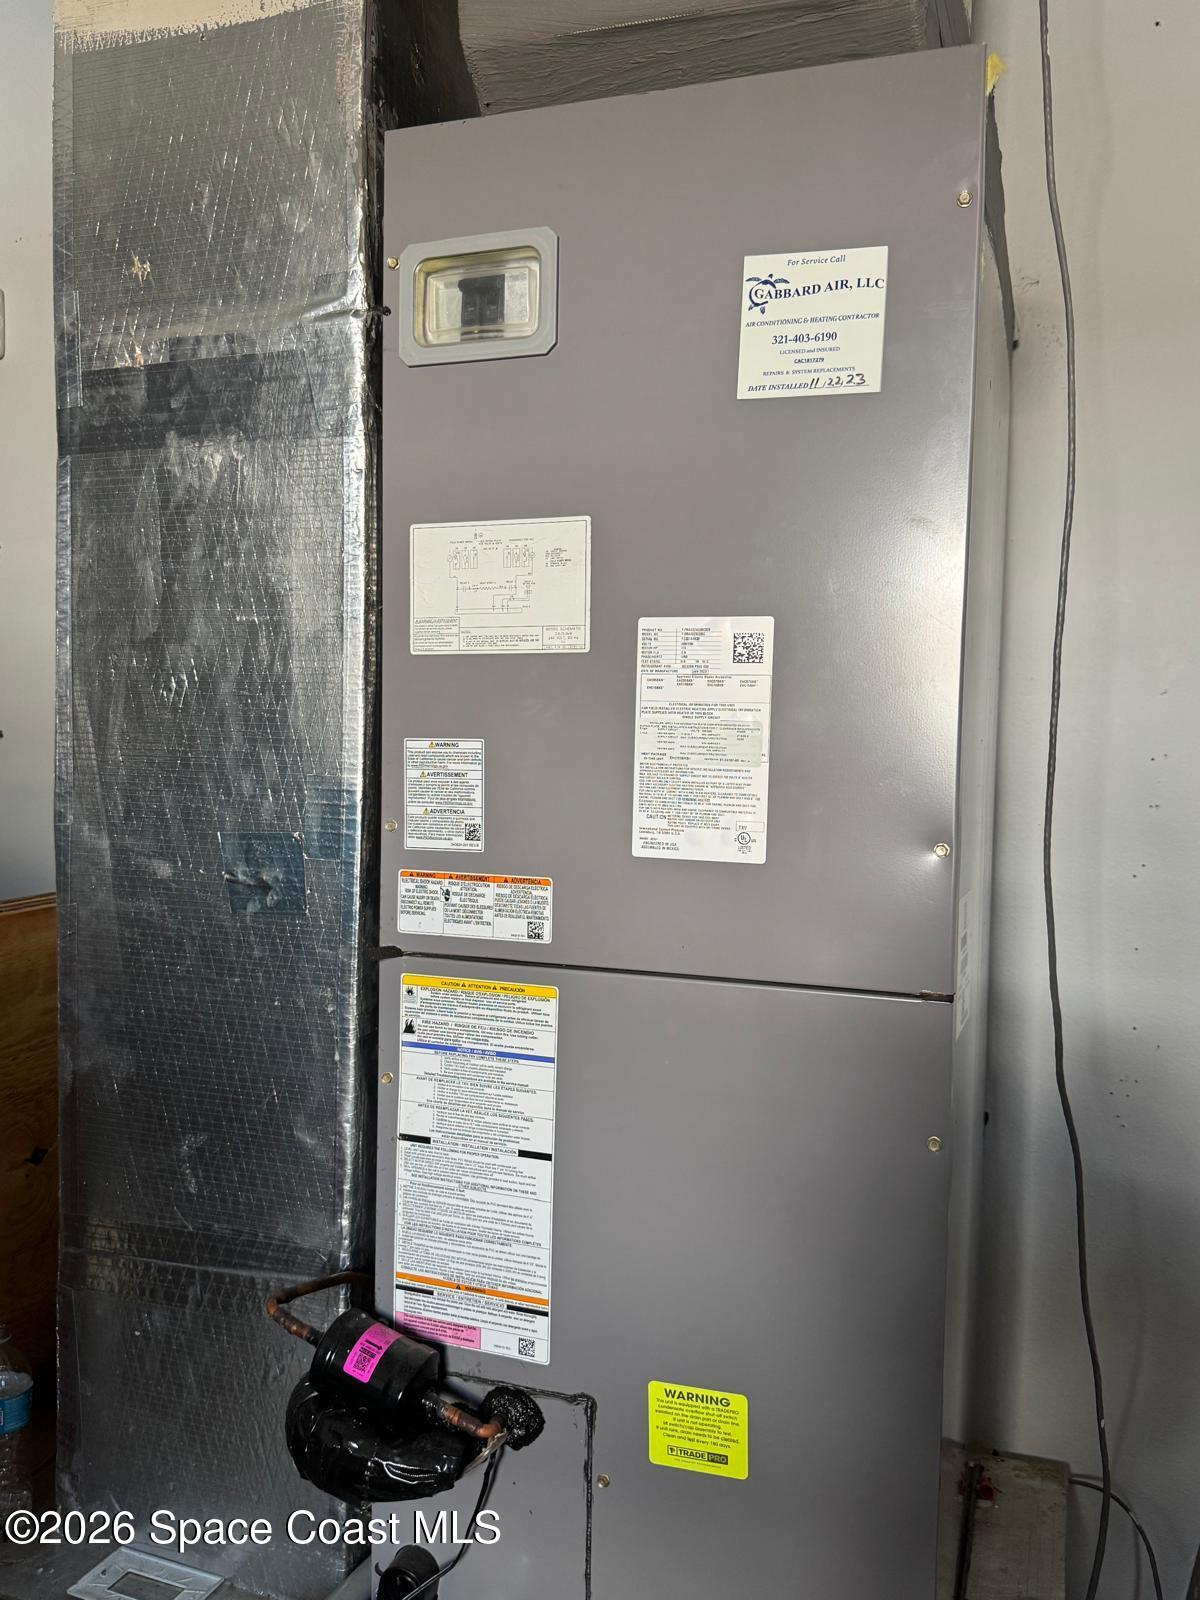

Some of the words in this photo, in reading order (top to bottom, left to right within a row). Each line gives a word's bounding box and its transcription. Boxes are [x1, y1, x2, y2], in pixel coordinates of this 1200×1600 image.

[801, 257, 828, 265] Service
[754, 284, 821, 299] GABBARD
[824, 280, 852, 292] AIR,
[856, 278, 885, 289] LLC
[756, 318, 802, 326] CONDITIONING
[838, 313, 880, 321] CONTRACTOR
[772, 332, 837, 344] 321-403-6190
[768, 380, 809, 390] INSTALLED
[664, 1388, 730, 1407] WARNING
